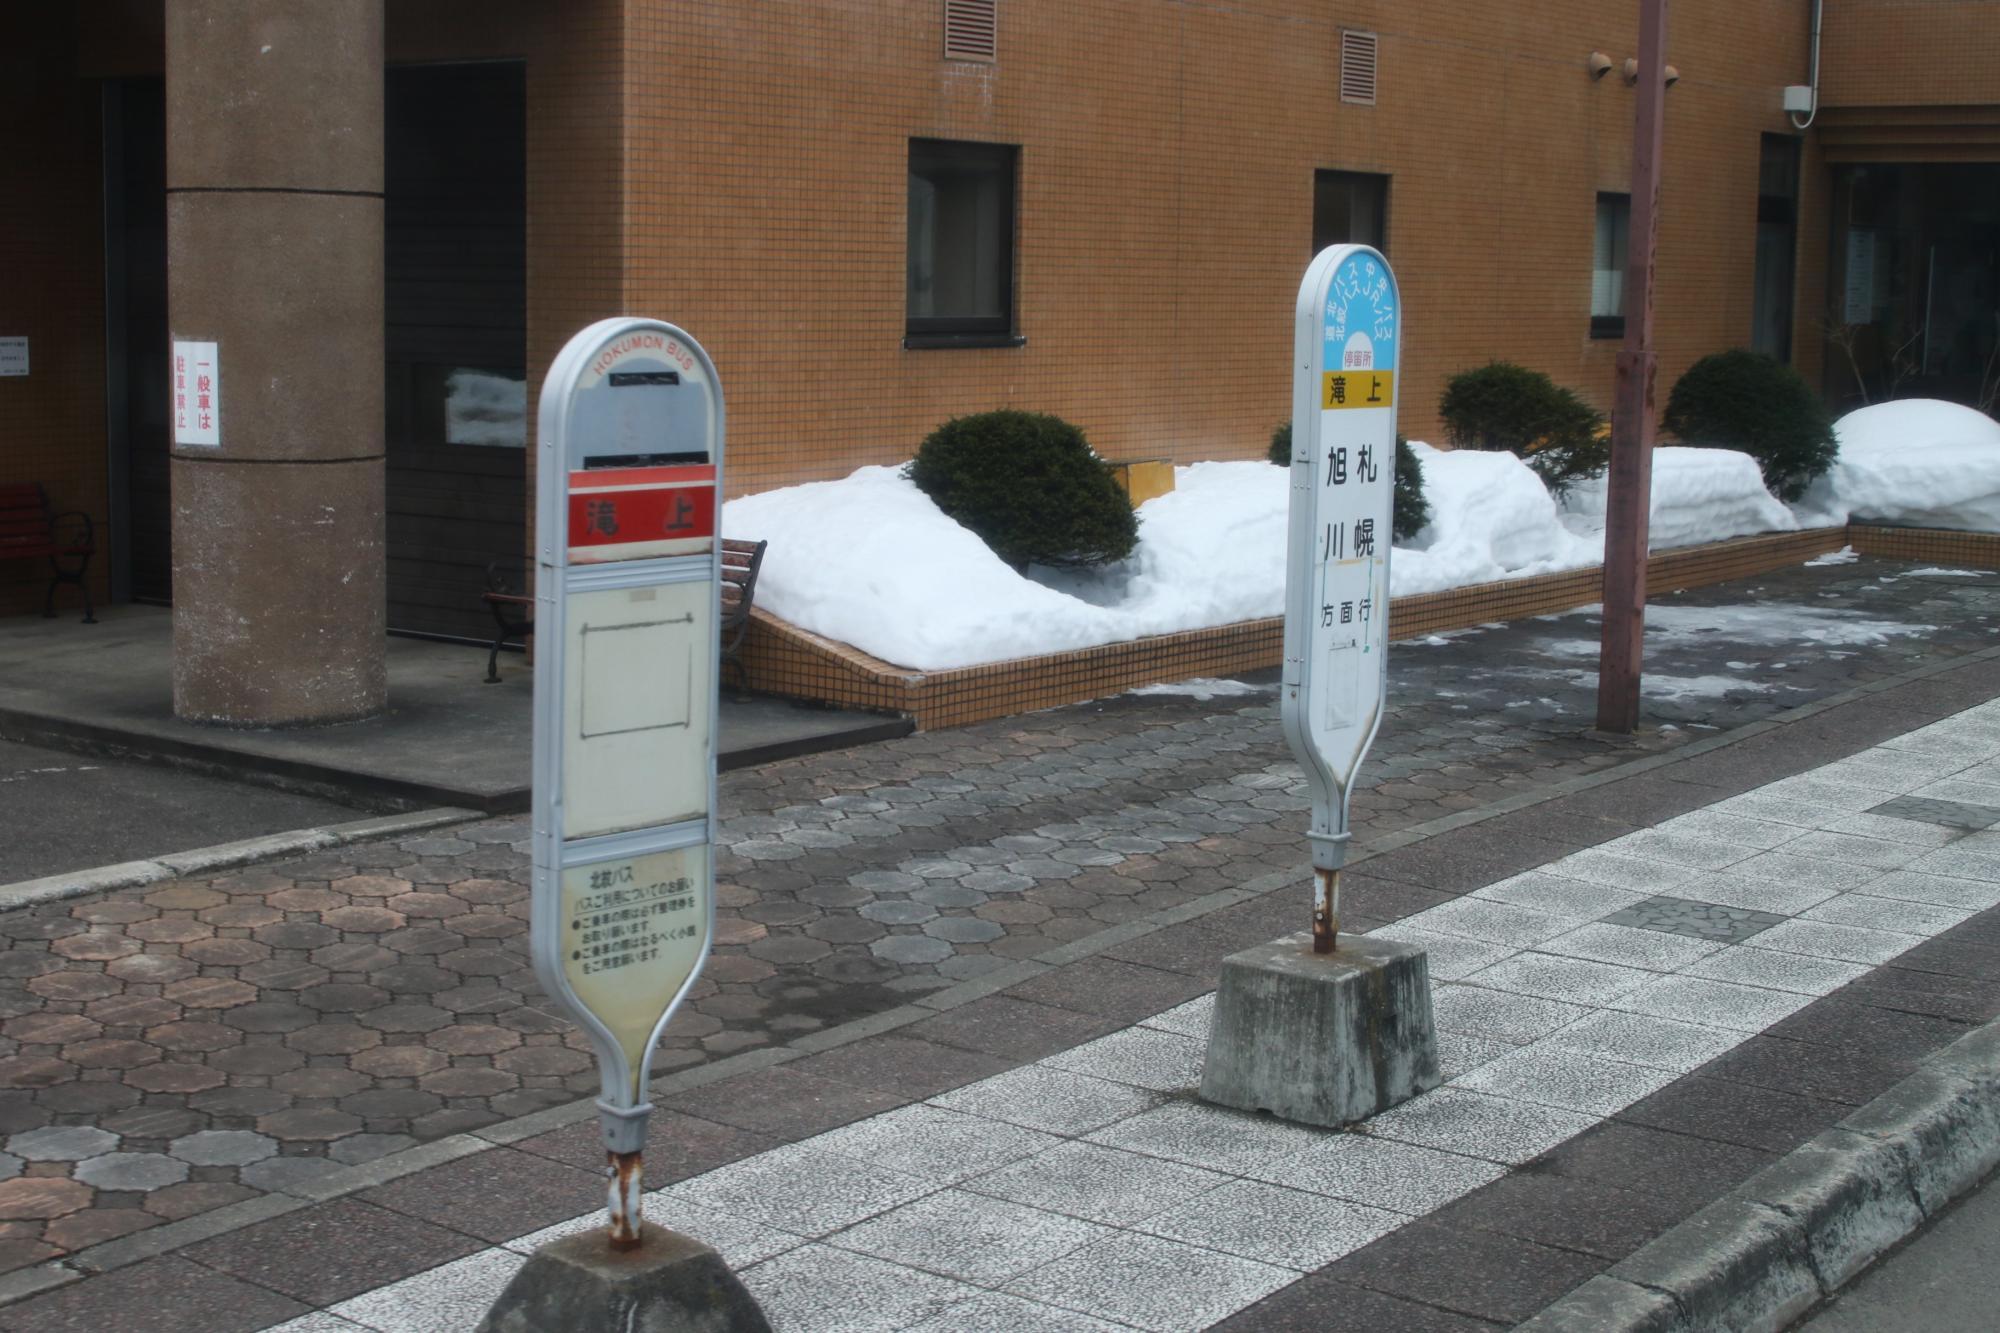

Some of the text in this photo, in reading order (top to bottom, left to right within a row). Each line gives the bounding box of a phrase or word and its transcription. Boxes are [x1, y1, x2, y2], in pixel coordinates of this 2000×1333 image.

[1366, 262, 1392, 341] 中央バス
[593, 335, 694, 376] HOKUMON BUS
[1344, 350, 1372, 368] 停留所
[176, 355, 186, 429] 駐車禁止
[197, 361, 211, 430] 一般車は
[1325, 446, 1347, 561] 旭川
[1354, 444, 1377, 558] 札幌
[1321, 599, 1372, 628] 方面行
